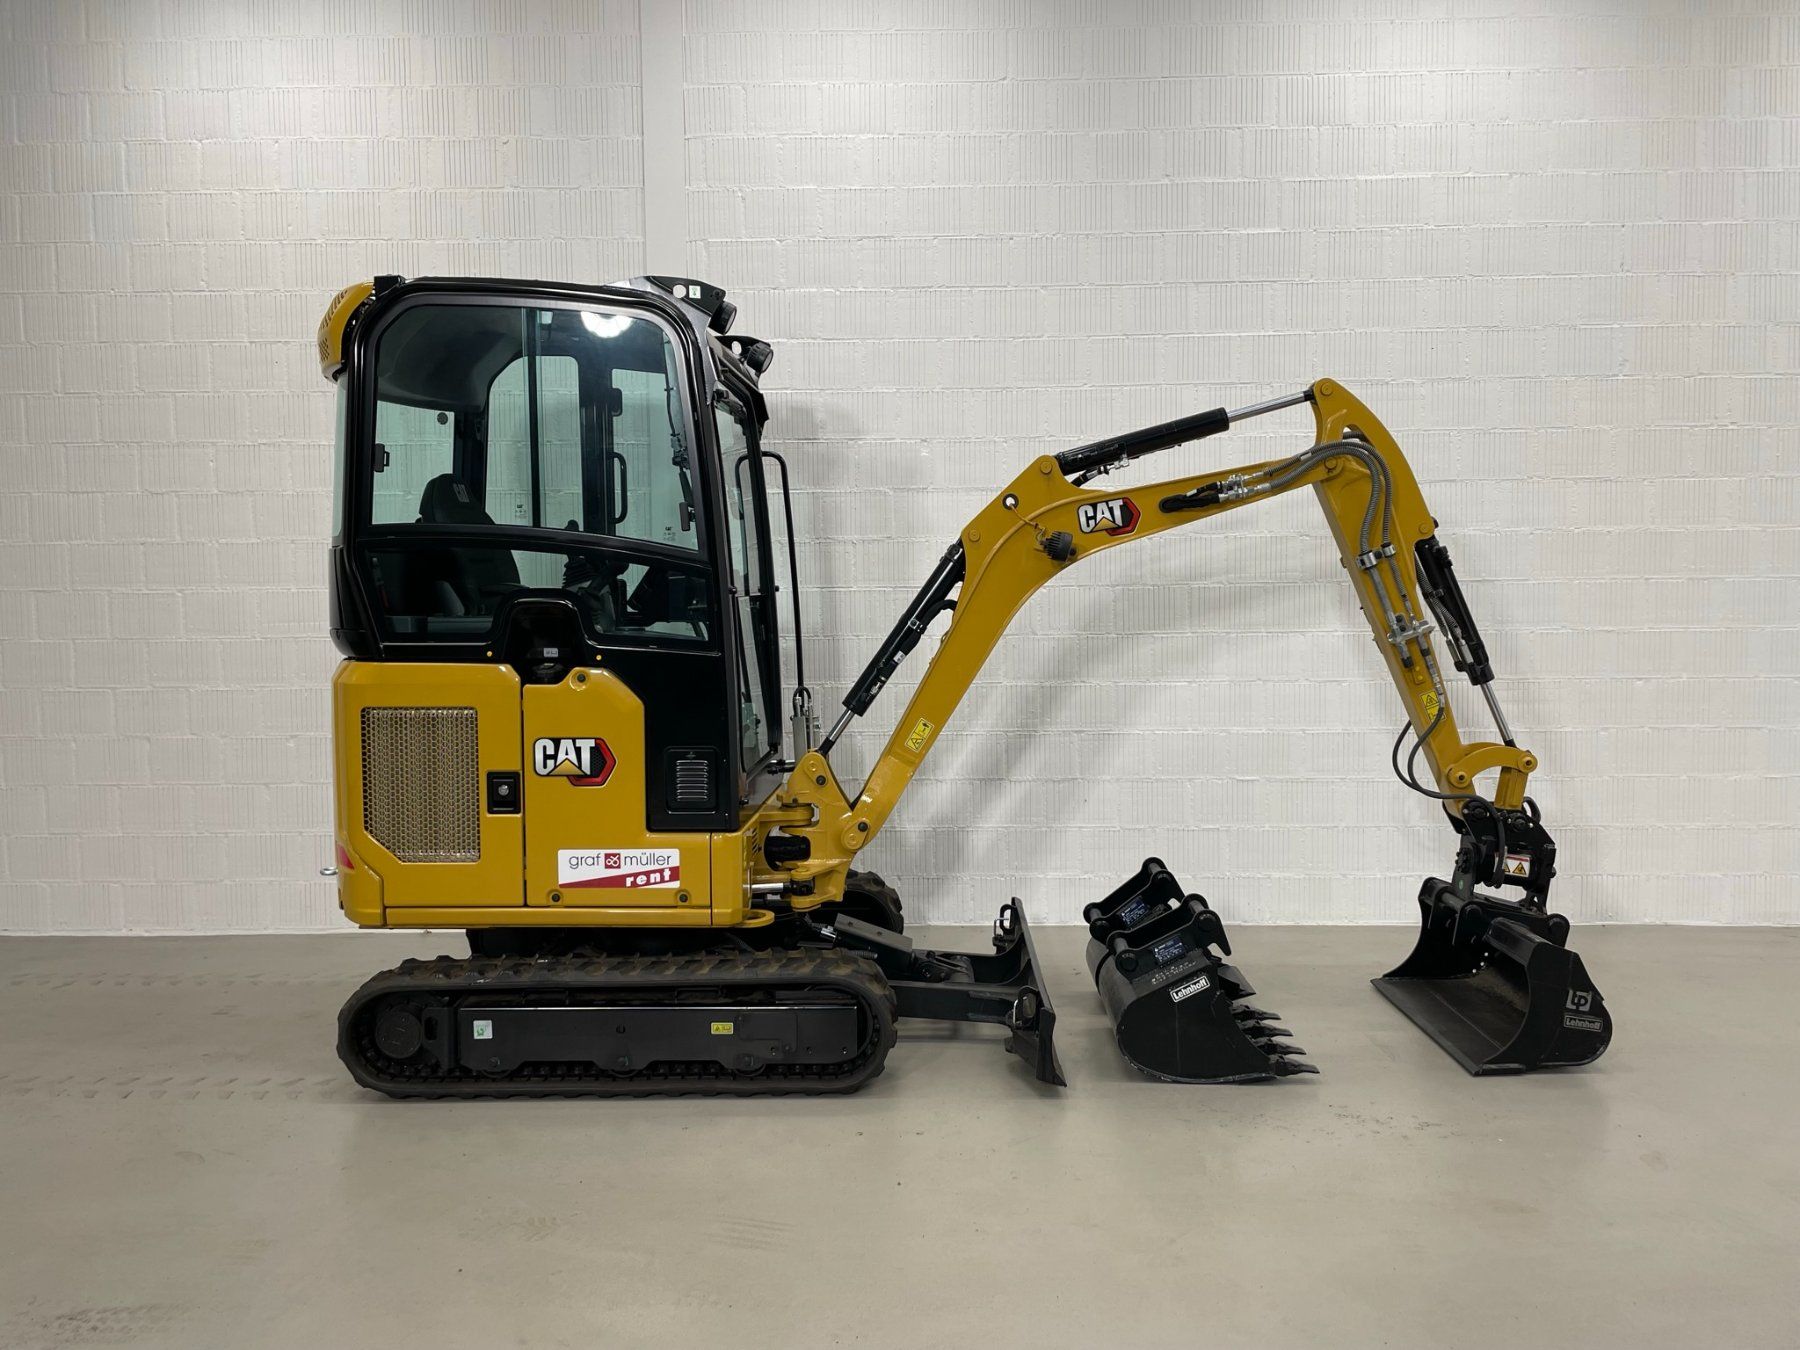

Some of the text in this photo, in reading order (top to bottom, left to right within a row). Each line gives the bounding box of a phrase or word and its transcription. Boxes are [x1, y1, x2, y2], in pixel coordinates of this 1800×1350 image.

[1078, 499, 1123, 533] CAT
[535, 738, 595, 775] CAT
[569, 852, 602, 869] graf
[624, 852, 672, 867] müller
[625, 868, 671, 887] rent
[1173, 978, 1207, 1000] Lehnhoff
[1566, 1018, 1601, 1030] Lehnhoff
